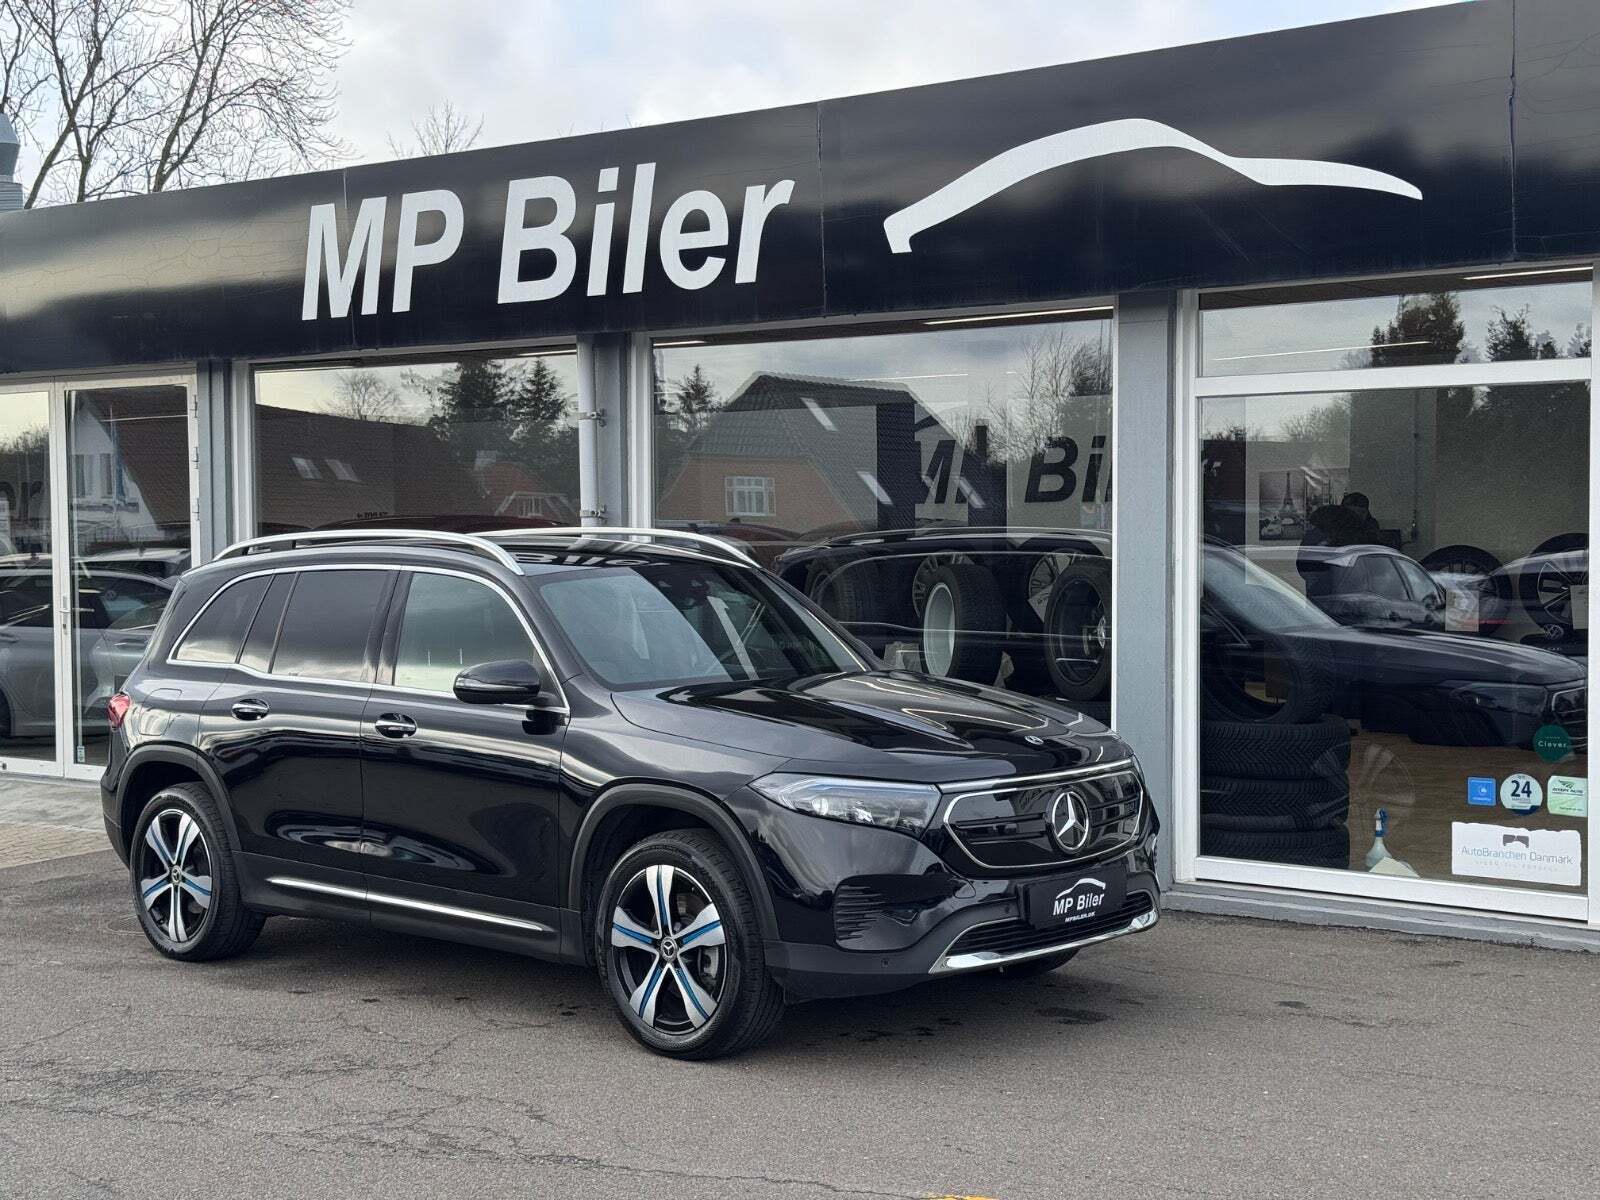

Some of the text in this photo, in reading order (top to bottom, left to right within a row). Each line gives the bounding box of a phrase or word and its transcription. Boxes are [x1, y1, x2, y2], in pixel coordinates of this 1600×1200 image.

[302, 162, 795, 320] MP Biler
[1023, 435, 1112, 504] Bi
[1537, 740, 1567, 749] Clever
[1510, 779, 1533, 798] 24
[1461, 846, 1574, 865] AutoBranchen Danmark
[1053, 892, 1105, 916] MP Biler
